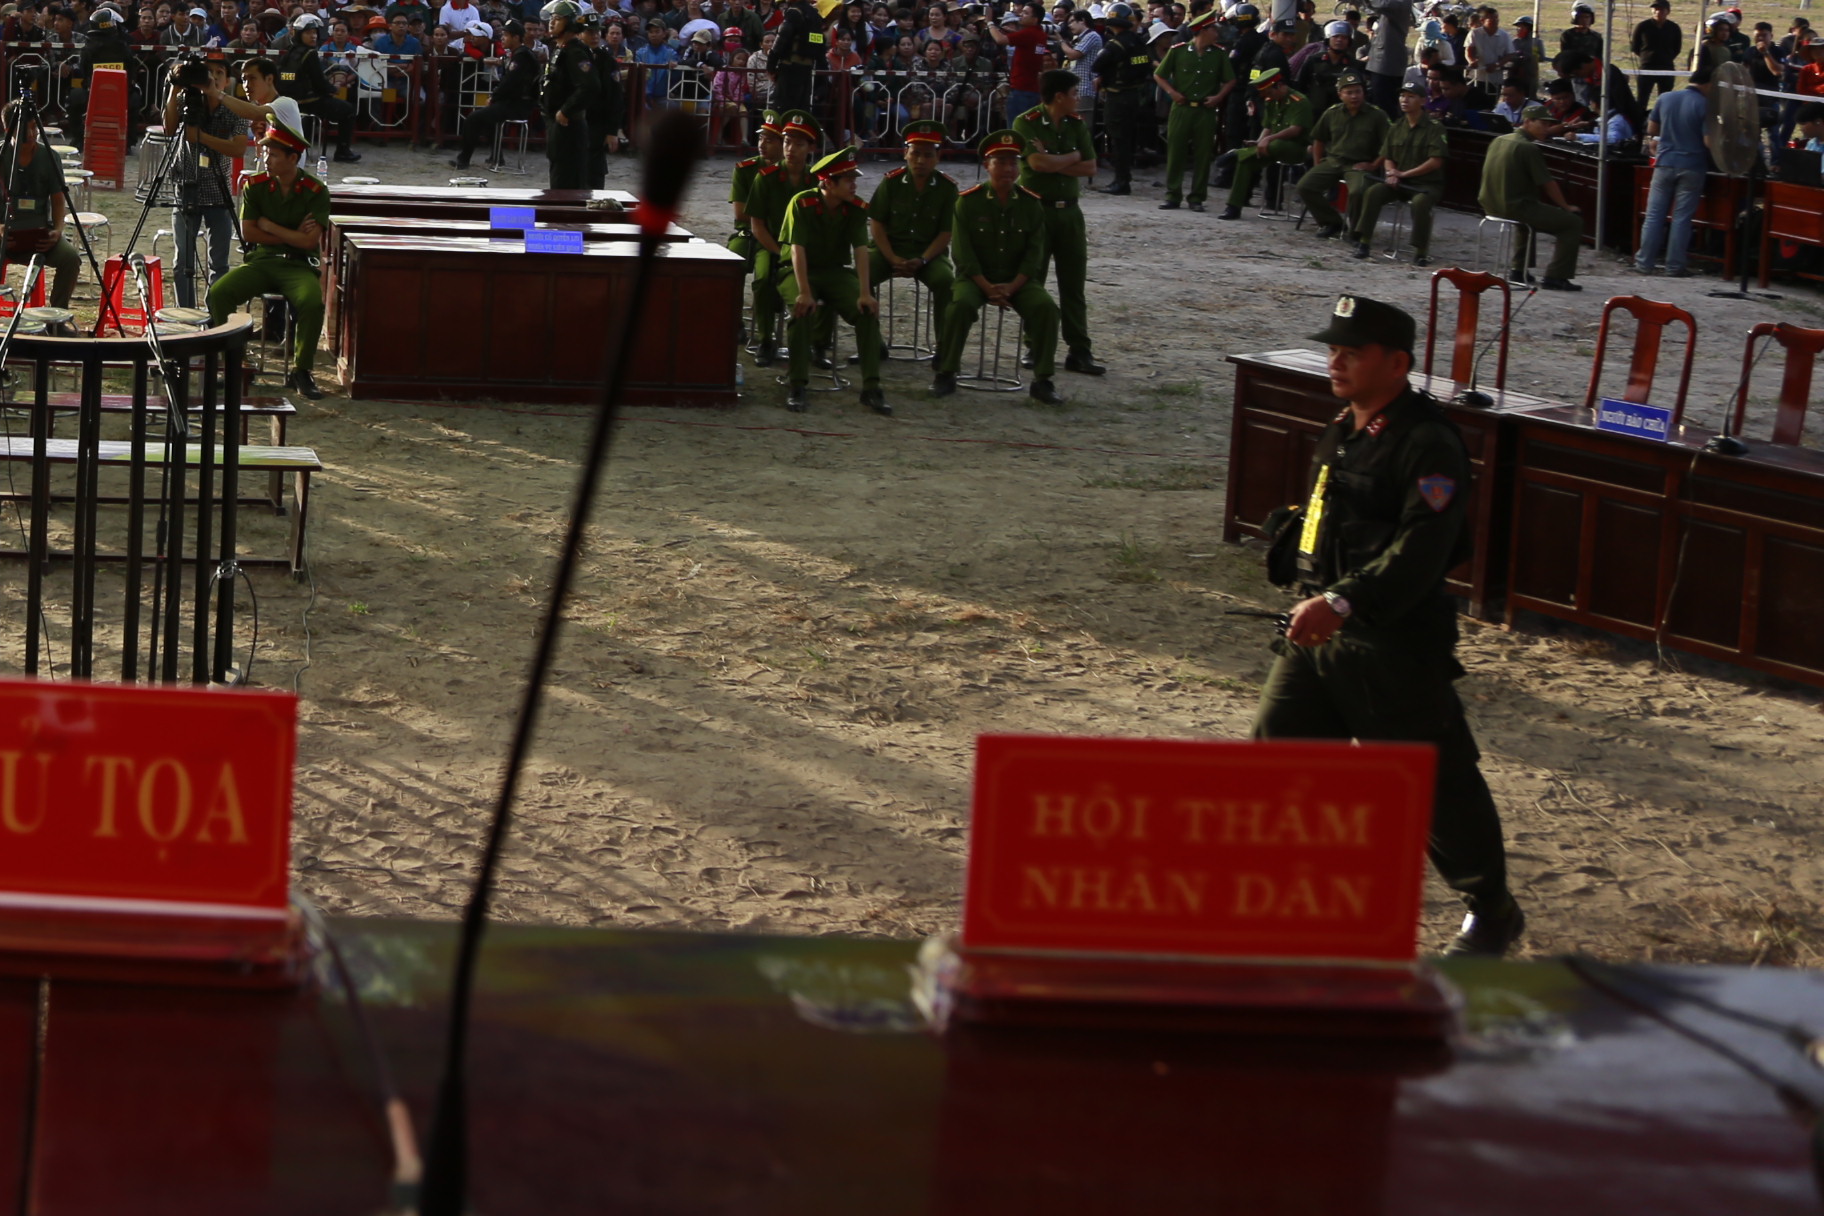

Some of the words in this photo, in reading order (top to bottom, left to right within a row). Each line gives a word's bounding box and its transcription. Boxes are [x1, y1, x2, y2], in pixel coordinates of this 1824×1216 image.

[86, 756, 249, 862] TỌA
[1029, 783, 1152, 850] HỘI
[1020, 858, 1207, 915] NHÂN
[1233, 861, 1373, 920] DÂN
